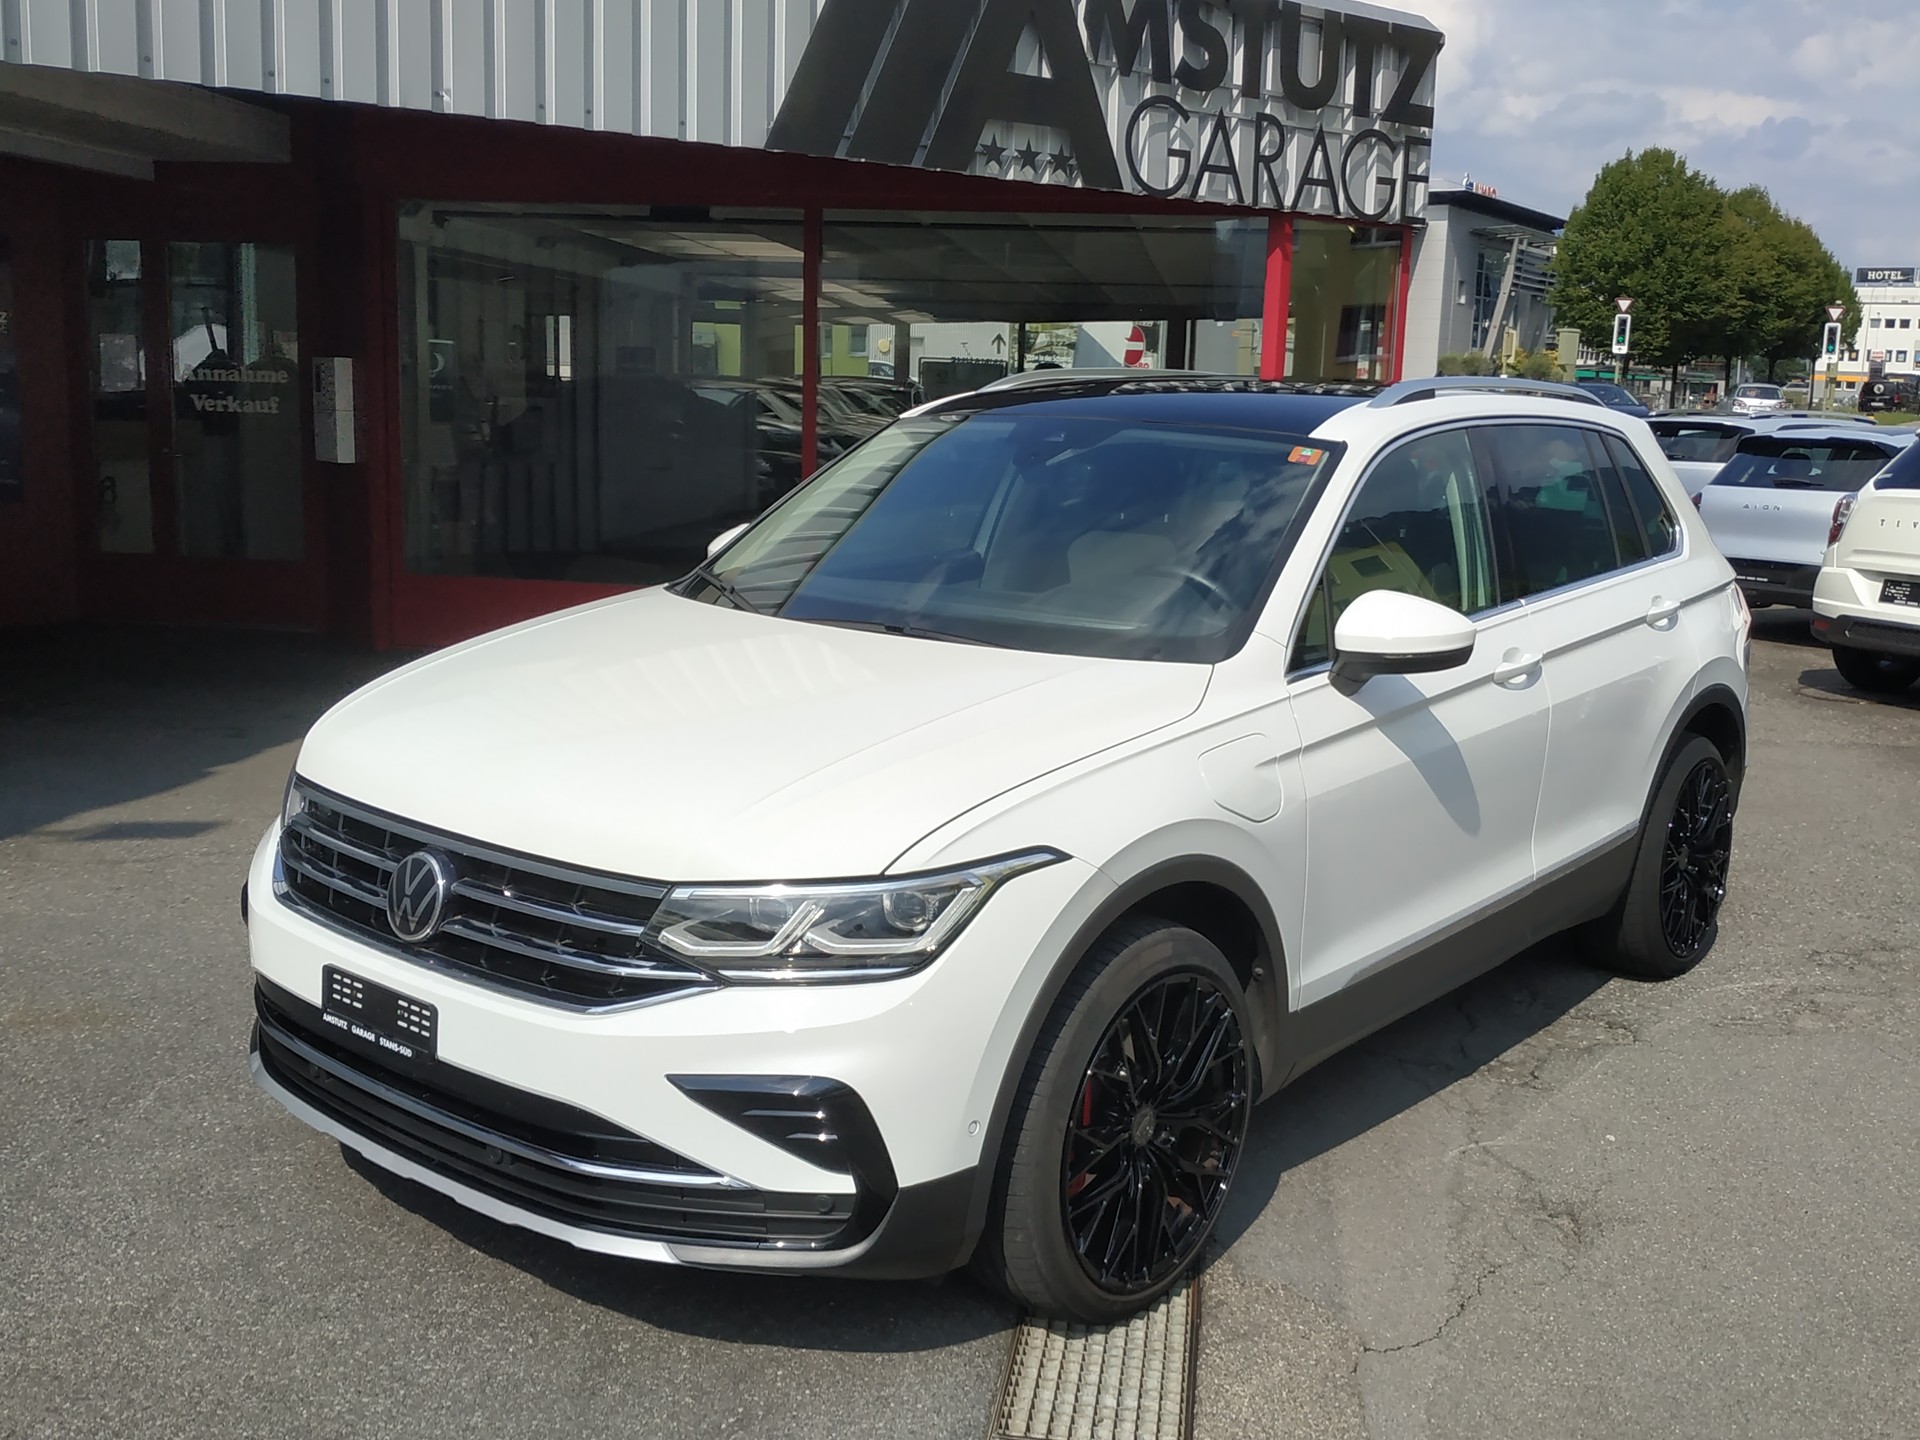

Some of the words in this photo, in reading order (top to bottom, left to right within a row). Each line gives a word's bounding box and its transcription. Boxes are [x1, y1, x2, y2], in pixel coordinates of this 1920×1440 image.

[1125, 95, 1432, 225] GARAGE
[1867, 270, 1902, 280] HOTEL
[189, 393, 280, 414] Verkauf
[1742, 503, 1781, 511] AION
[323, 1013, 348, 1030] AMSTUTZ
[351, 1025, 376, 1042] GARAGE
